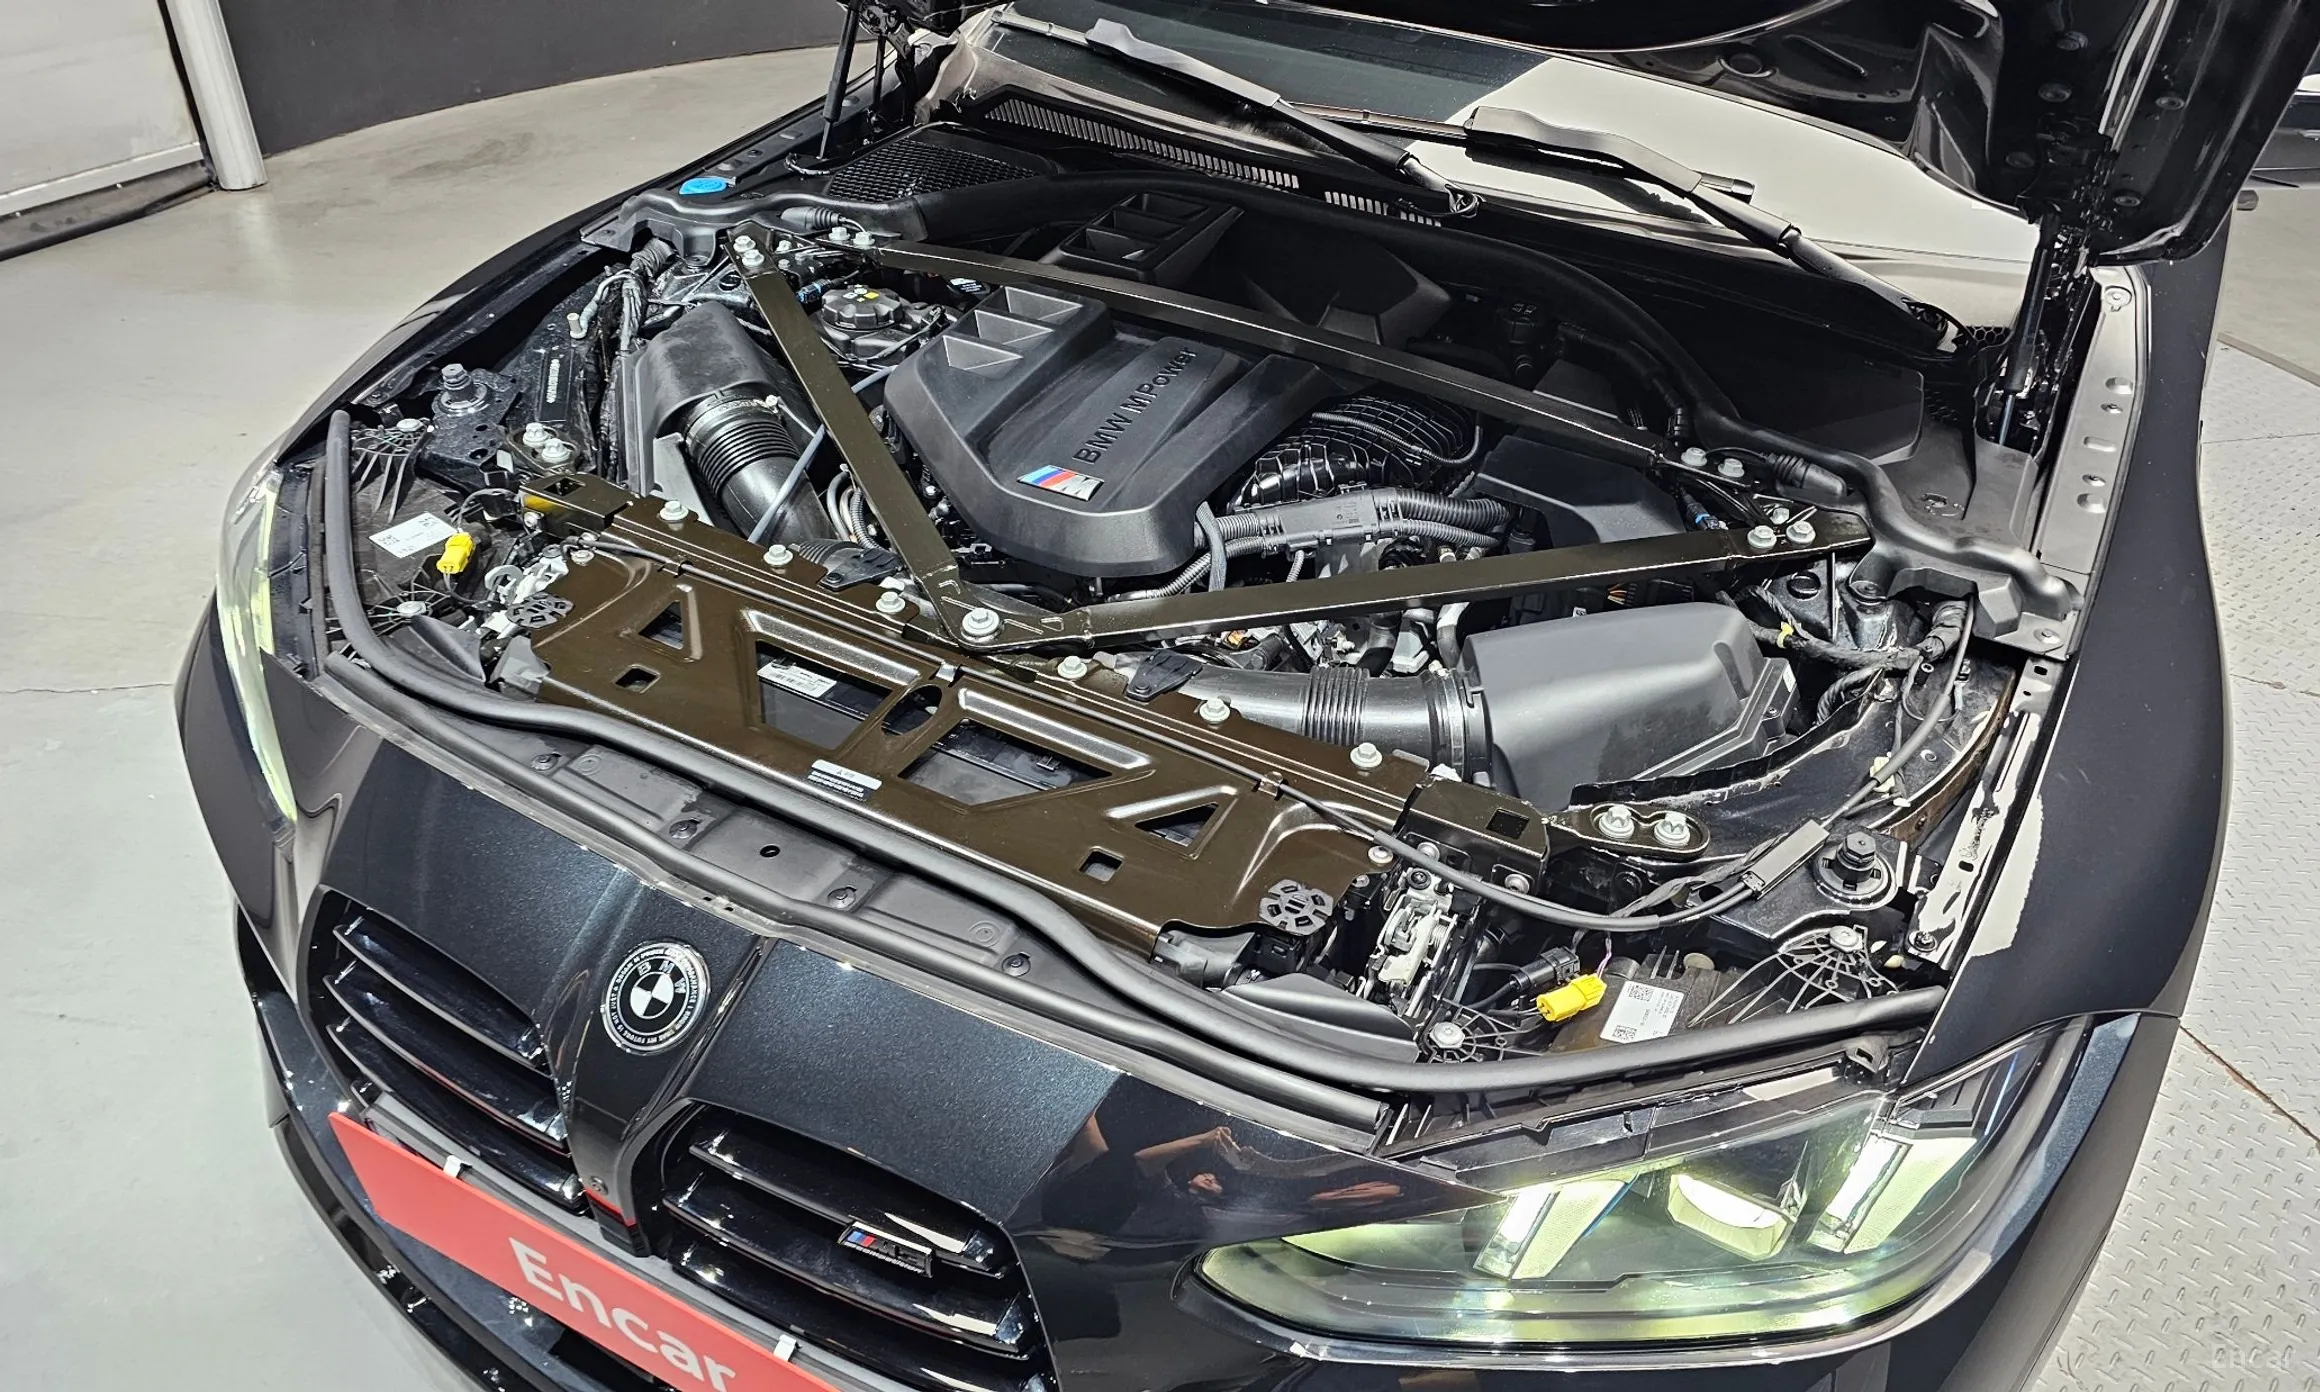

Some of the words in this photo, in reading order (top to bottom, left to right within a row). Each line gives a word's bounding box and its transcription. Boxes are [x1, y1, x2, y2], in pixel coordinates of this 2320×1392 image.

[1073, 413, 1133, 464] BMW
[636, 959, 687, 993] BMW
[508, 1237, 736, 1392] Encar
